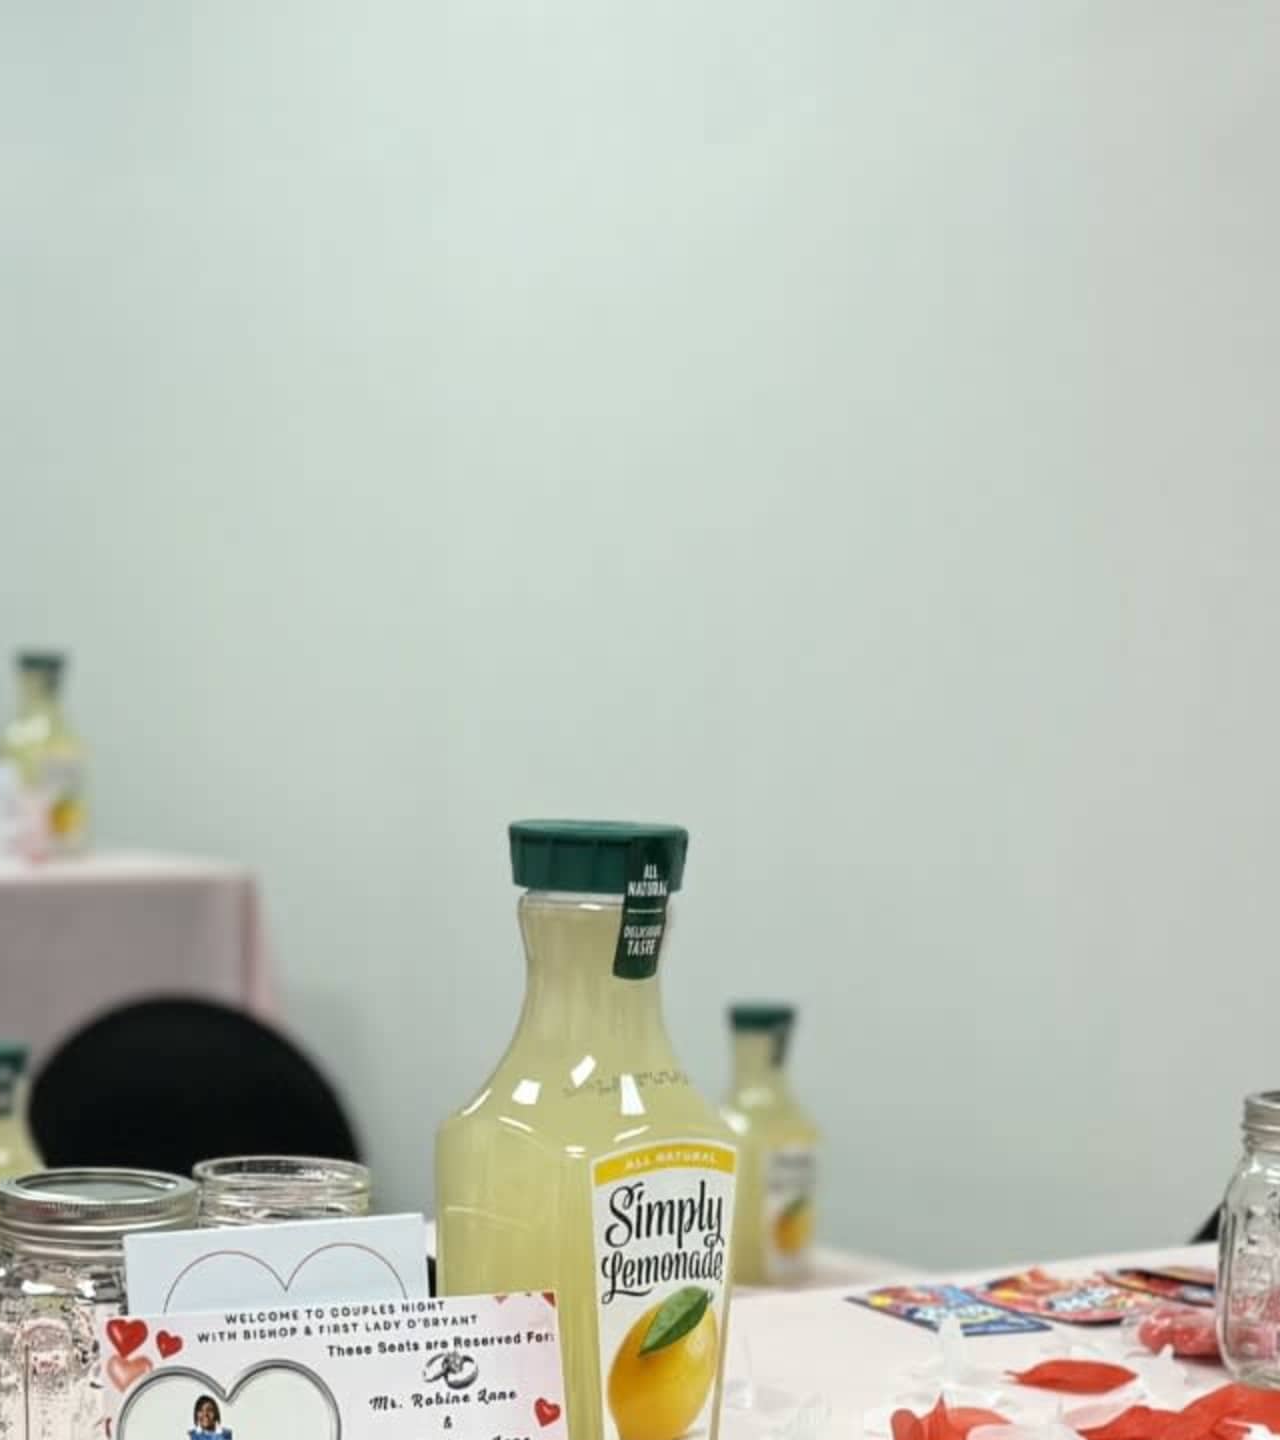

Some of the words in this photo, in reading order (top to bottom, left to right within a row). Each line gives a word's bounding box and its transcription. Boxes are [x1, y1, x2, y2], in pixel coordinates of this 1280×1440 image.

[627, 939, 656, 956] TASTE
[605, 1179, 725, 1249] Simply
[601, 1242, 723, 1304] Lemonade
[225, 1309, 299, 1325] WELCOME
[306, 1308, 324, 1320] TO
[330, 1304, 396, 1318] COUPLES
[401, 1300, 445, 1313] NIGHT
[198, 1331, 237, 1344] WITH
[243, 1326, 298, 1340] BISHOP
[304, 1325, 313, 1336] &
[319, 1323, 359, 1335] FIRST
[365, 1320, 401, 1332] LADY
[407, 1314, 478, 1329] O'BRYANT
[327, 1344, 373, 1357] These
[378, 1340, 420, 1354] Seats
[425, 1339, 449, 1351] are
[453, 1331, 521, 1349] Reserved
[370, 1395, 403, 1411] Mr.
